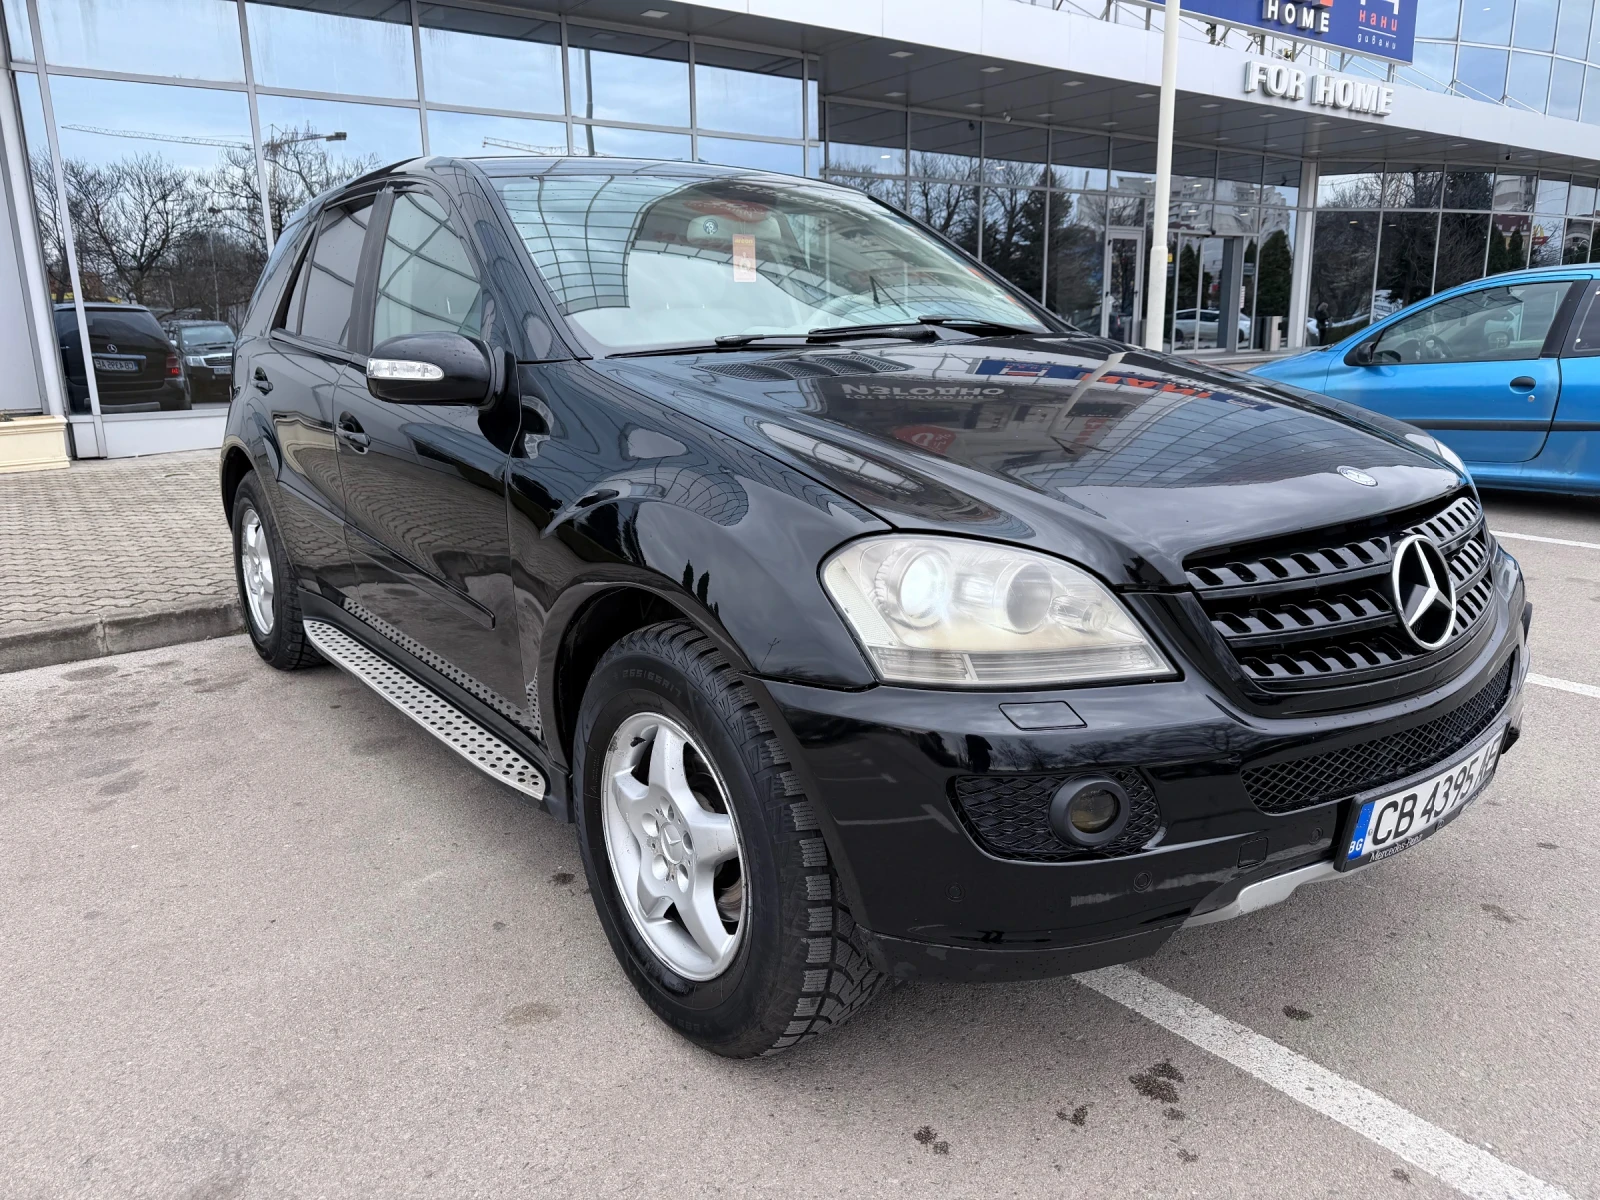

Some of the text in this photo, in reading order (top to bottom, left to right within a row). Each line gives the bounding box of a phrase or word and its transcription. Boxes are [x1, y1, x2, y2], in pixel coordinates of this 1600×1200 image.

[1265, 3, 1330, 33] HOME
[1245, 61, 1394, 116] FOR HOME
[1372, 793, 1418, 846] CB
[1420, 754, 1480, 824] 4395
[1348, 838, 1364, 854] BG
[1369, 833, 1423, 863] Mercedes-Benz
